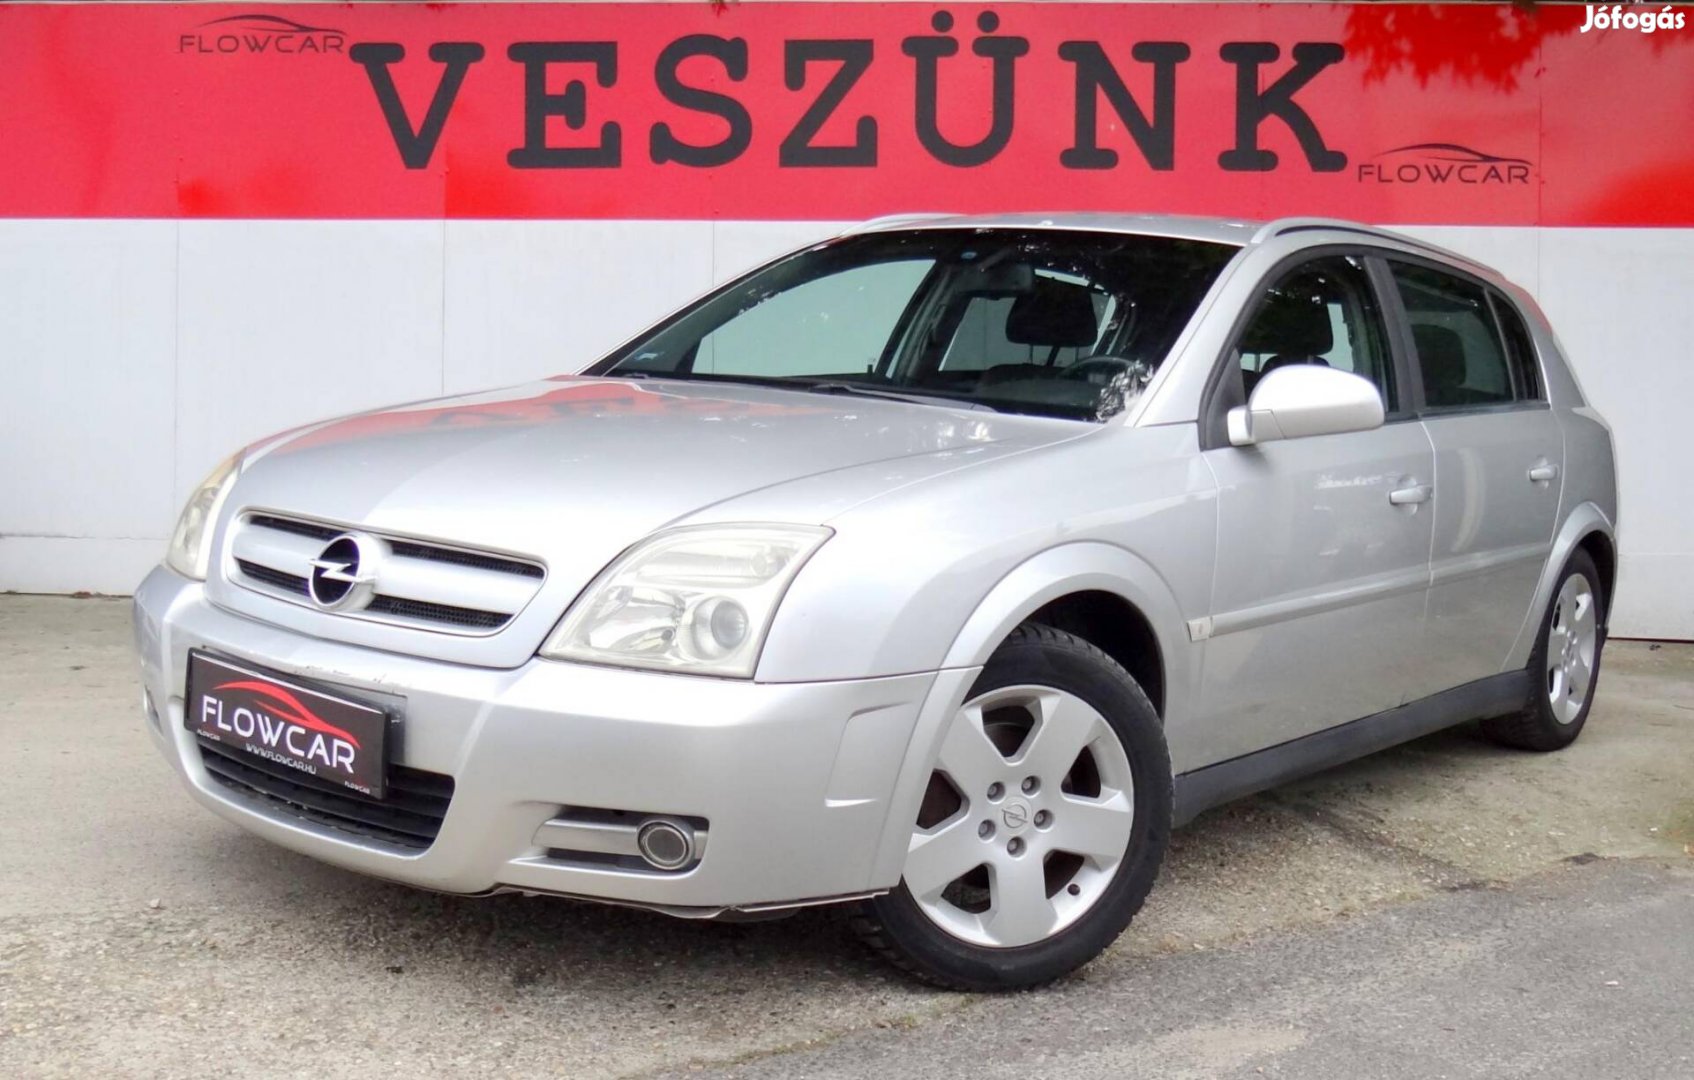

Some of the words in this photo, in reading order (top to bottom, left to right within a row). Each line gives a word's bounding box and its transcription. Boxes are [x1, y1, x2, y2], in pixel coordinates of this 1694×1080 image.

[180, 34, 345, 54] FLOWCAR
[349, 10, 1348, 172] VESZÜNK
[1358, 163, 1530, 185] FLOWCAR
[202, 694, 356, 774] FLOWCAR
